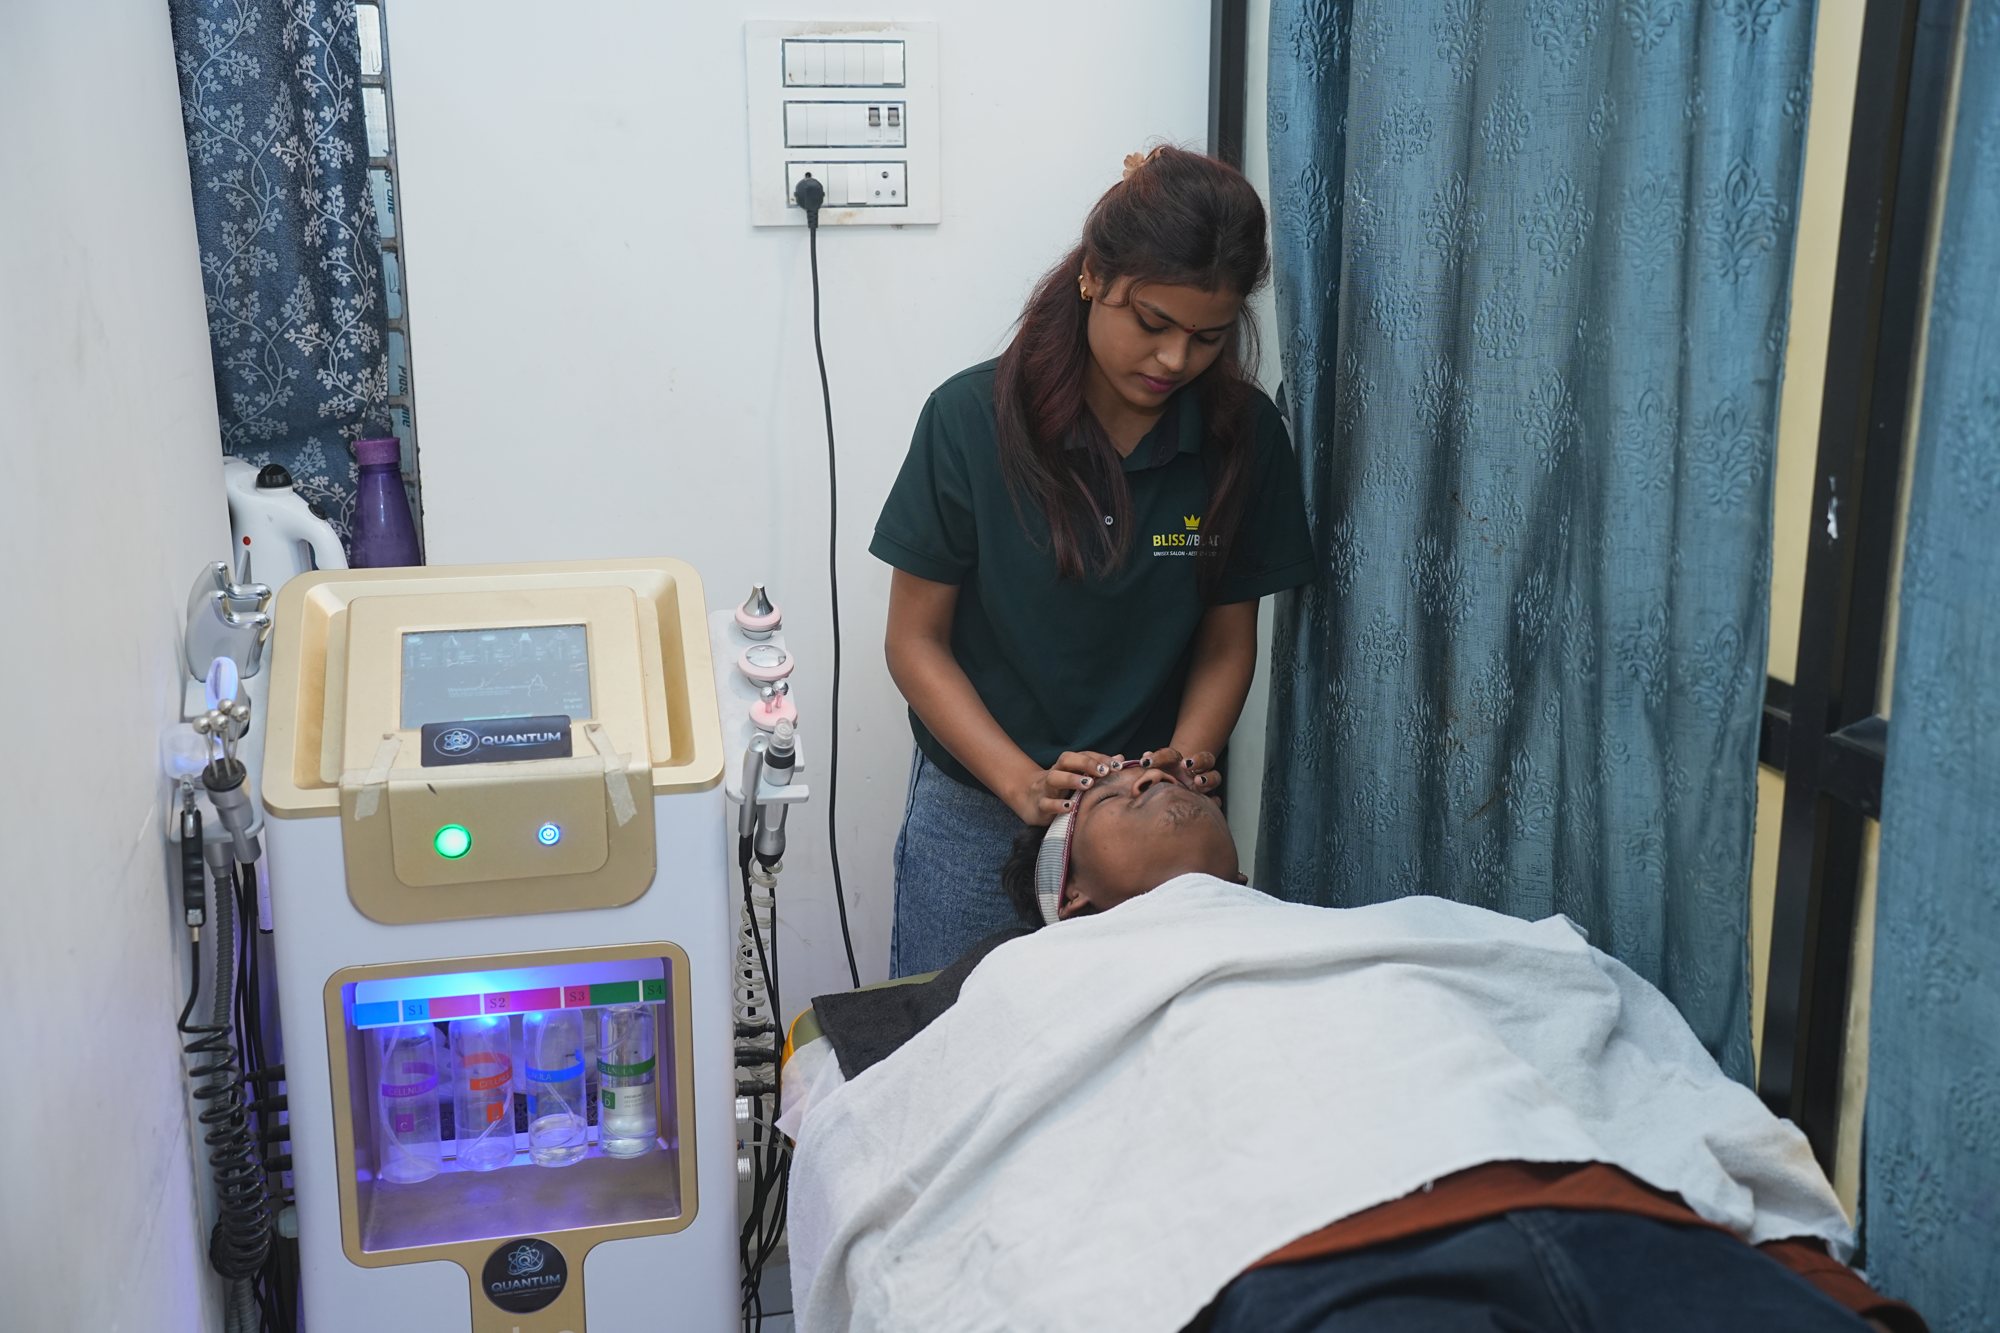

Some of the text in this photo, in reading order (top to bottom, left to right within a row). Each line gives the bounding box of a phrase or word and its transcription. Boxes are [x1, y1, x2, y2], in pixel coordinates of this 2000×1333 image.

[481, 732, 561, 745] QUANTUM
[647, 984, 663, 995] S4
[569, 990, 585, 1003] S3
[408, 1004, 423, 1016] S1
[489, 997, 506, 1010] S2
[491, 1274, 560, 1292] QUANTUM
